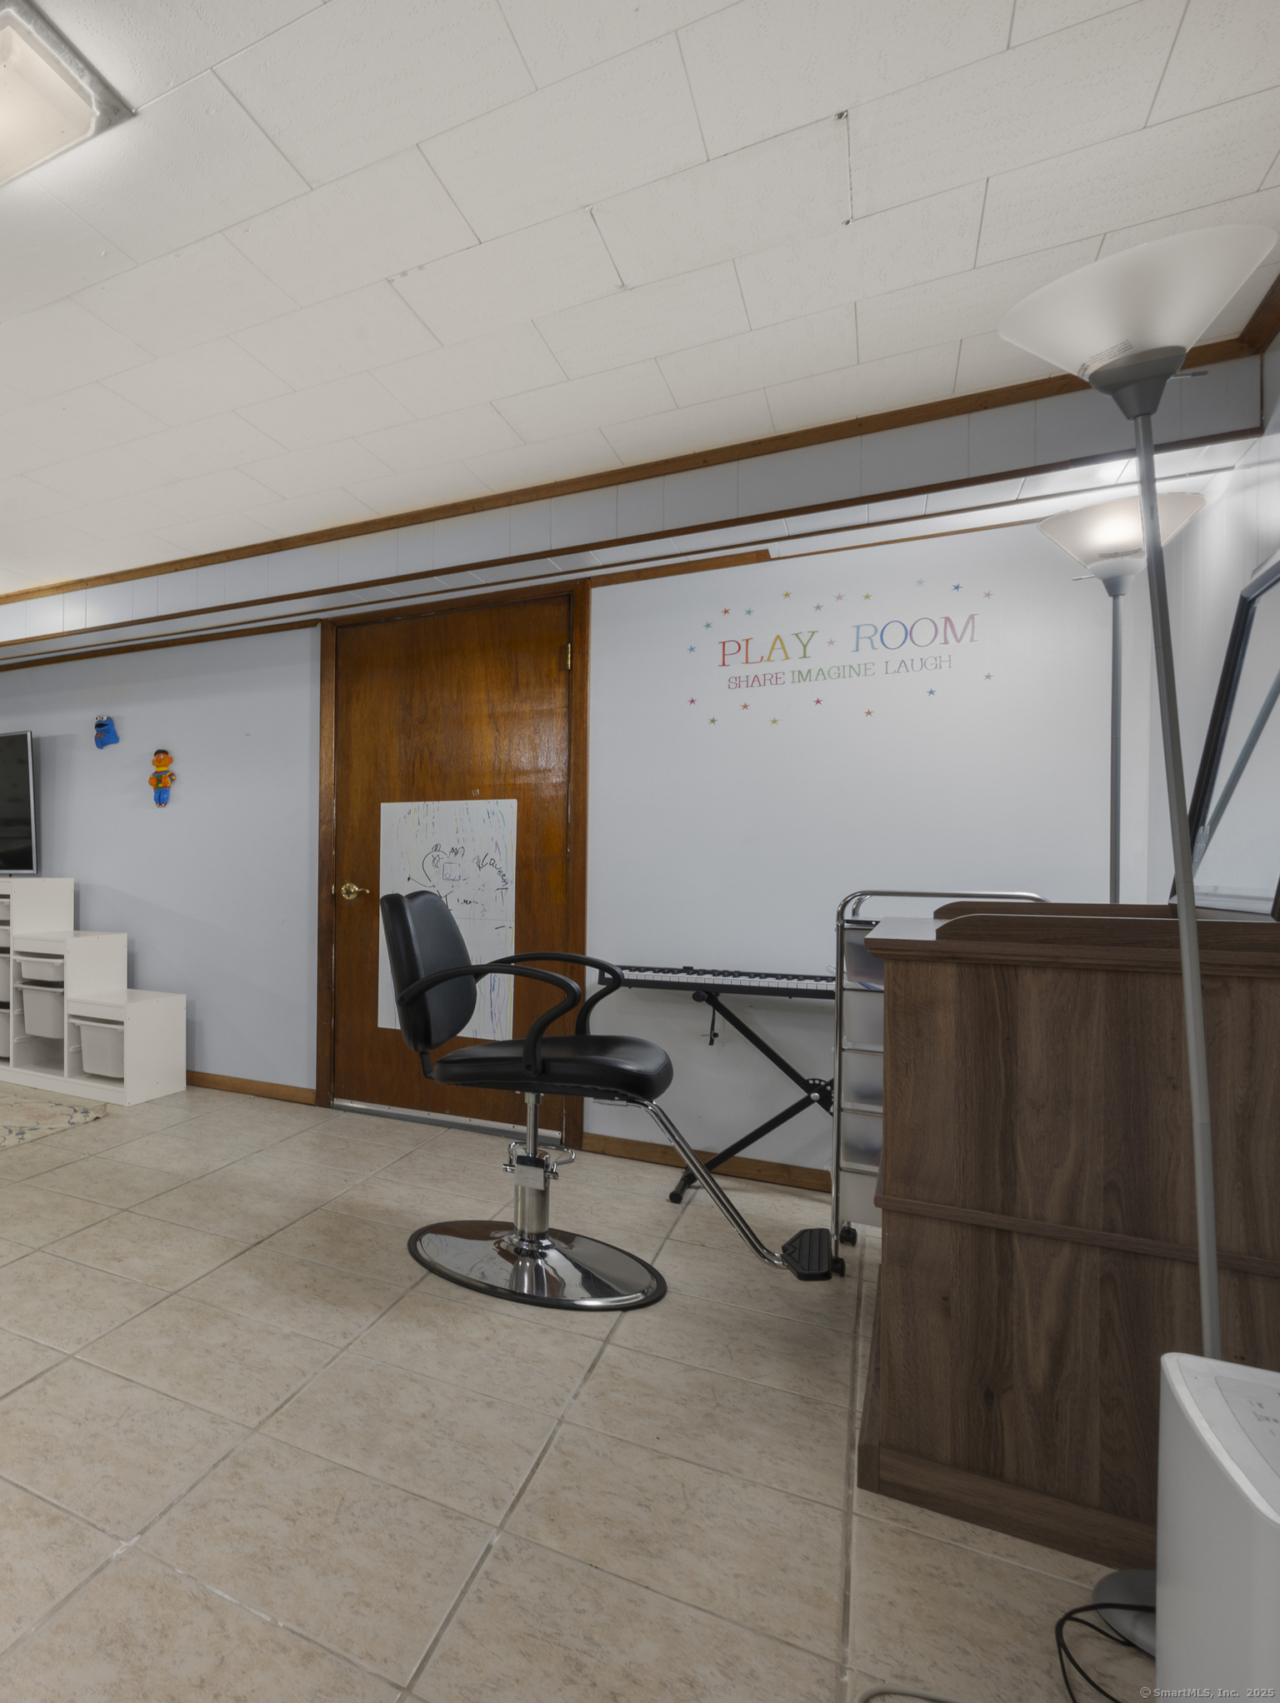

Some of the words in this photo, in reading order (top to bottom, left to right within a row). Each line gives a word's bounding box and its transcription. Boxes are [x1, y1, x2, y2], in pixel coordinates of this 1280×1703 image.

[718, 630, 819, 668] PLAY
[851, 613, 980, 653] ROOM
[727, 671, 786, 690] SHARE
[790, 662, 876, 684] IMAGINE
[884, 655, 953, 676] LAUGH
